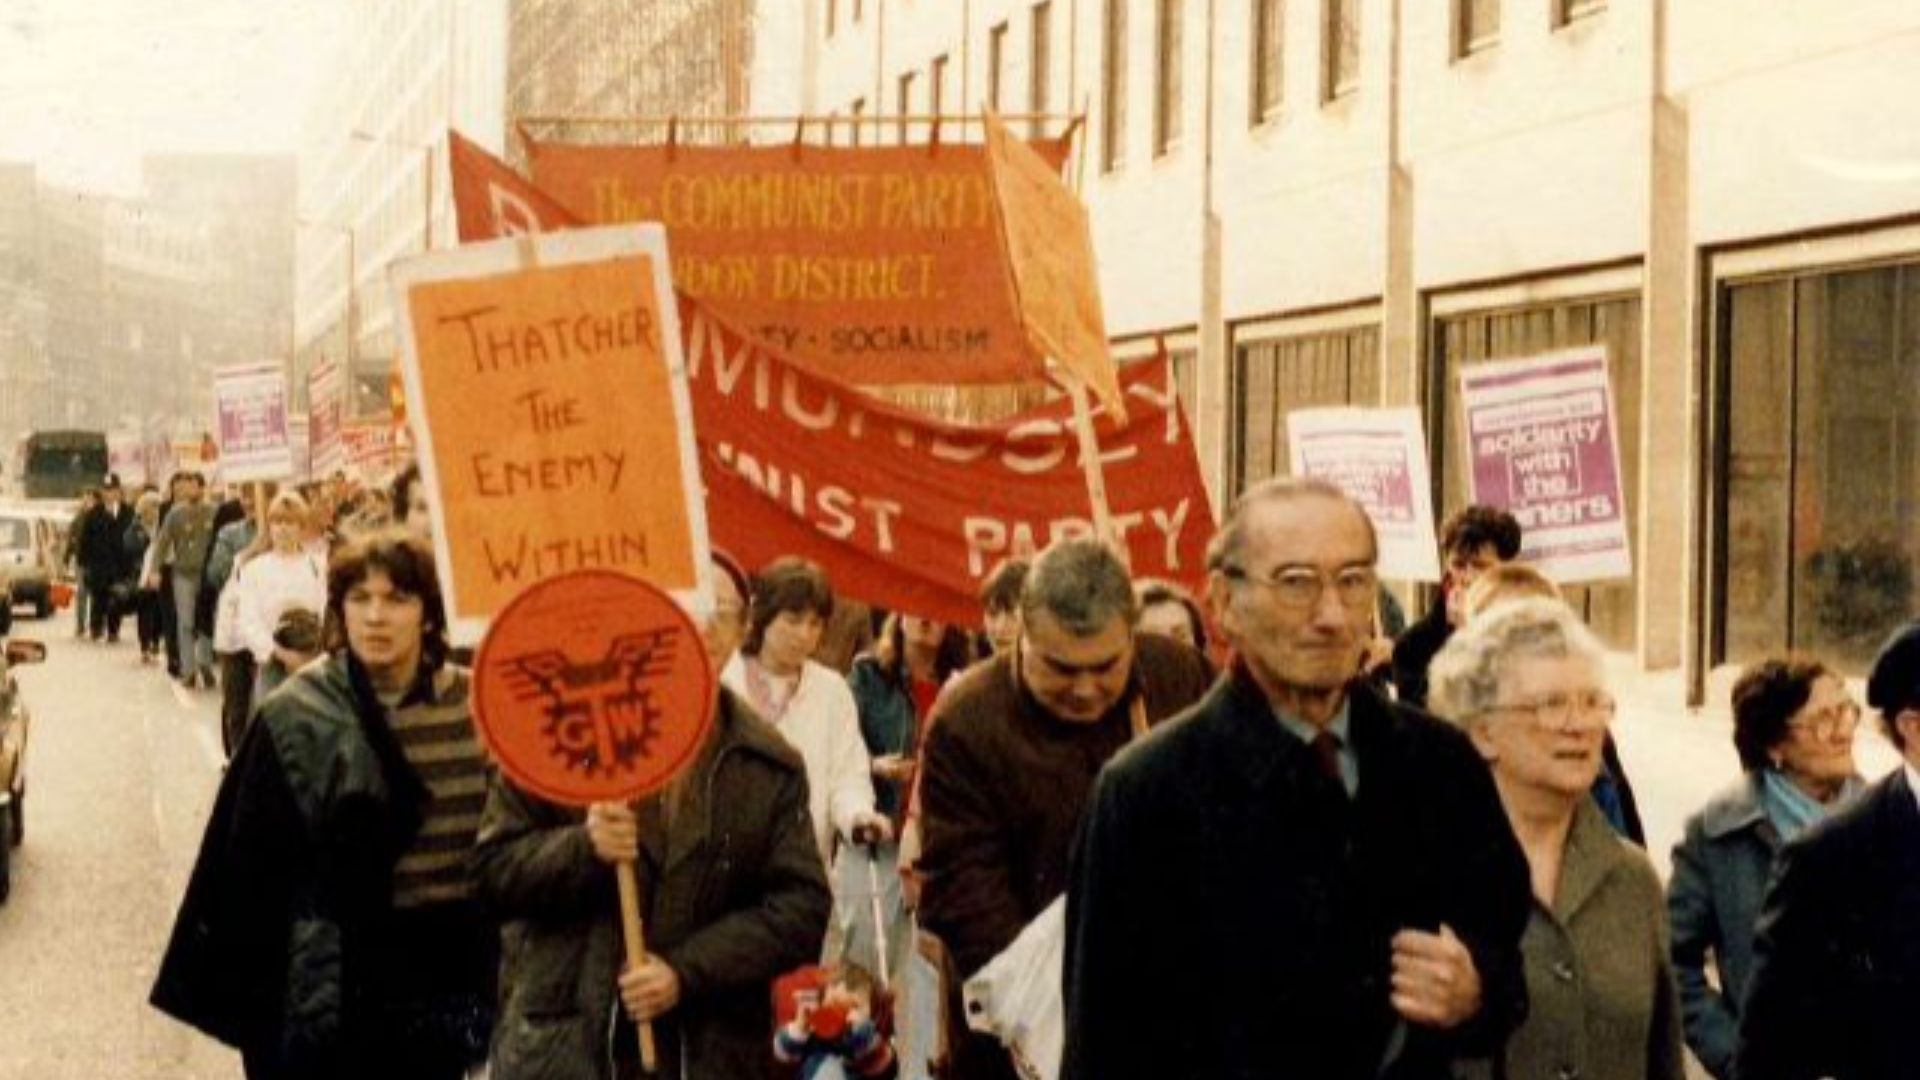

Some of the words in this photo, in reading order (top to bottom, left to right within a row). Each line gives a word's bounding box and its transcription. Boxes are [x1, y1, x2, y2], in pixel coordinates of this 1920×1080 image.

[661, 169, 867, 232] COMMUNIST
[471, 451, 624, 498] ENEMY
[1514, 449, 1571, 476] with
[1522, 474, 1568, 499] the
[483, 532, 648, 583] WITHIN
